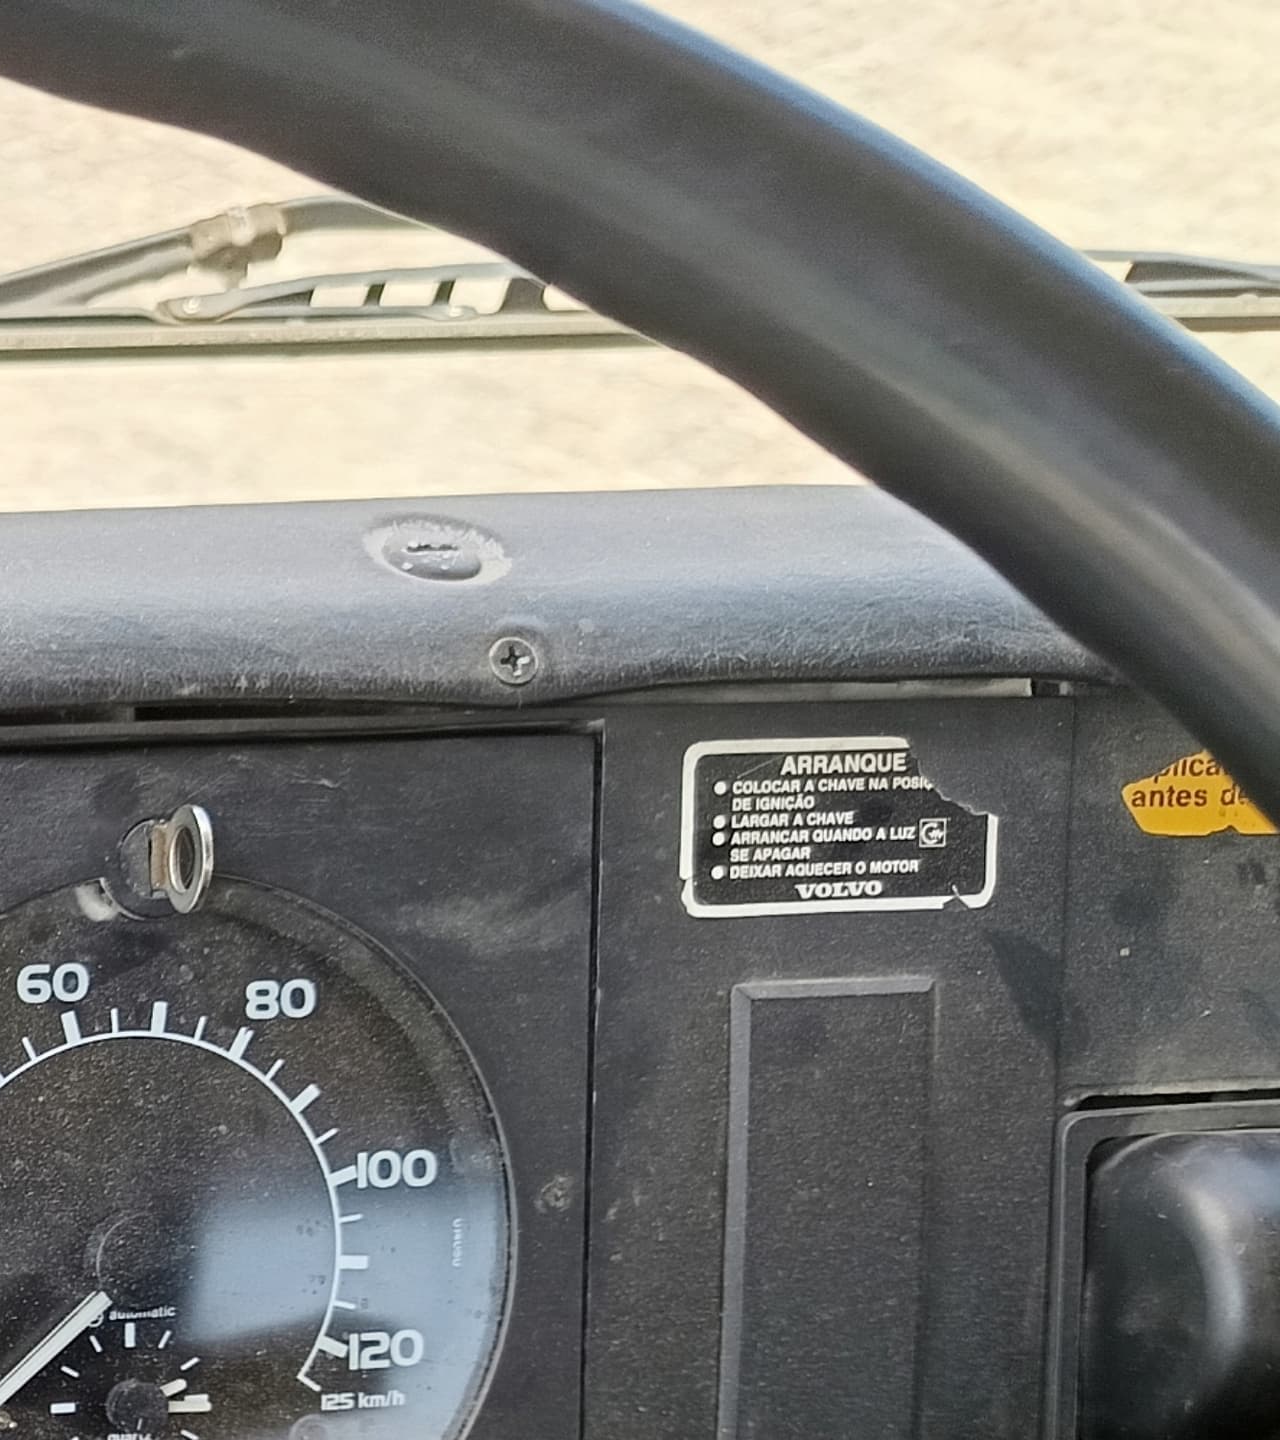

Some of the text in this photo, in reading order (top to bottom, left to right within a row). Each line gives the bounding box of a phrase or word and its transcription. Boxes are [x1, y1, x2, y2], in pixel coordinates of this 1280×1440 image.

[780, 752, 907, 776] ARRANQUE
[732, 778, 801, 794] COLOCAR
[804, 778, 815, 793] A
[818, 777, 865, 792] CHAVE
[868, 776, 888, 790] NA
[731, 794, 816, 812] DE IGNIÇÃO
[1131, 785, 1208, 808] antes
[730, 811, 855, 828] LARGAR A CHAVE
[730, 826, 916, 845] ARRANCAR QUANDO A LUZ
[730, 847, 811, 862] SE APAGAR
[729, 859, 919, 879] DEIXAR AQUECER O MOTOR
[795, 880, 883, 899] VOLVO
[16, 963, 89, 1003] 60
[245, 979, 316, 1020] 80
[356, 1149, 436, 1189] 100
[349, 1329, 424, 1371] 120
[321, 1390, 406, 1411] 125 km/h
